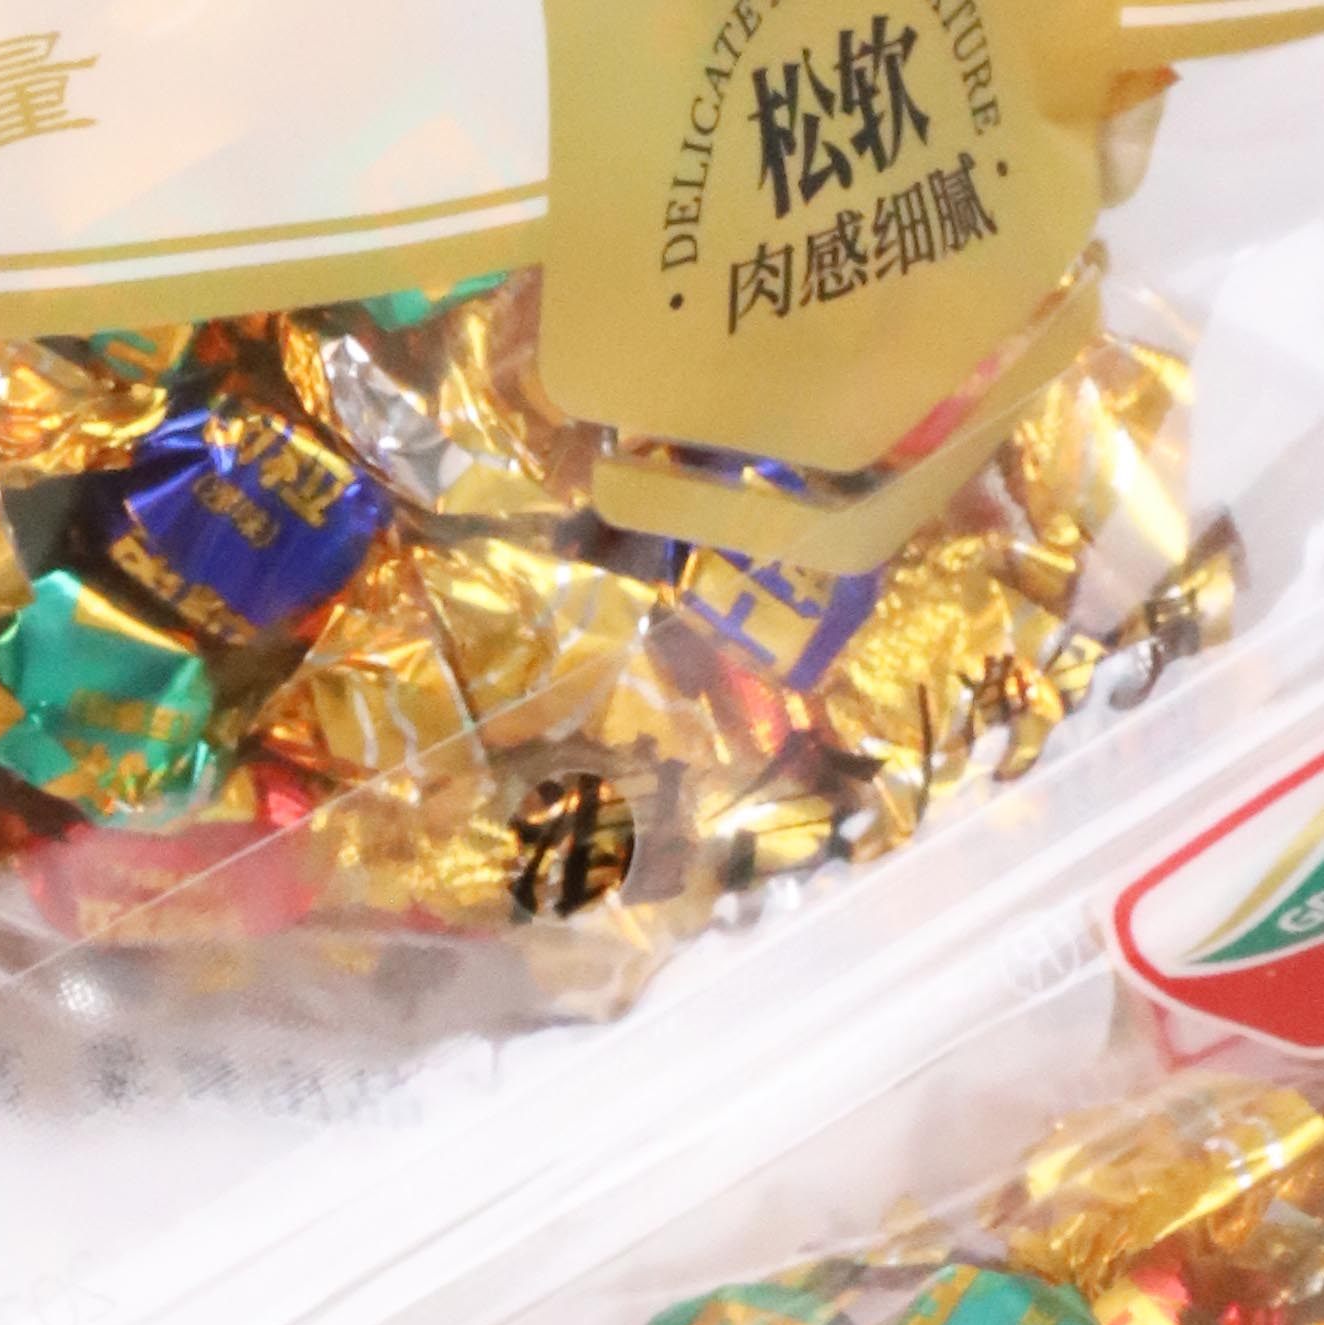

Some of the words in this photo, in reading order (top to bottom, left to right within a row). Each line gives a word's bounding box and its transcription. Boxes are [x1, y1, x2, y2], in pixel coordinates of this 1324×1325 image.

[749, 14, 930, 219] 松软
[925, 0, 1000, 136] TURE
[727, 152, 998, 336] 肉感细腻
